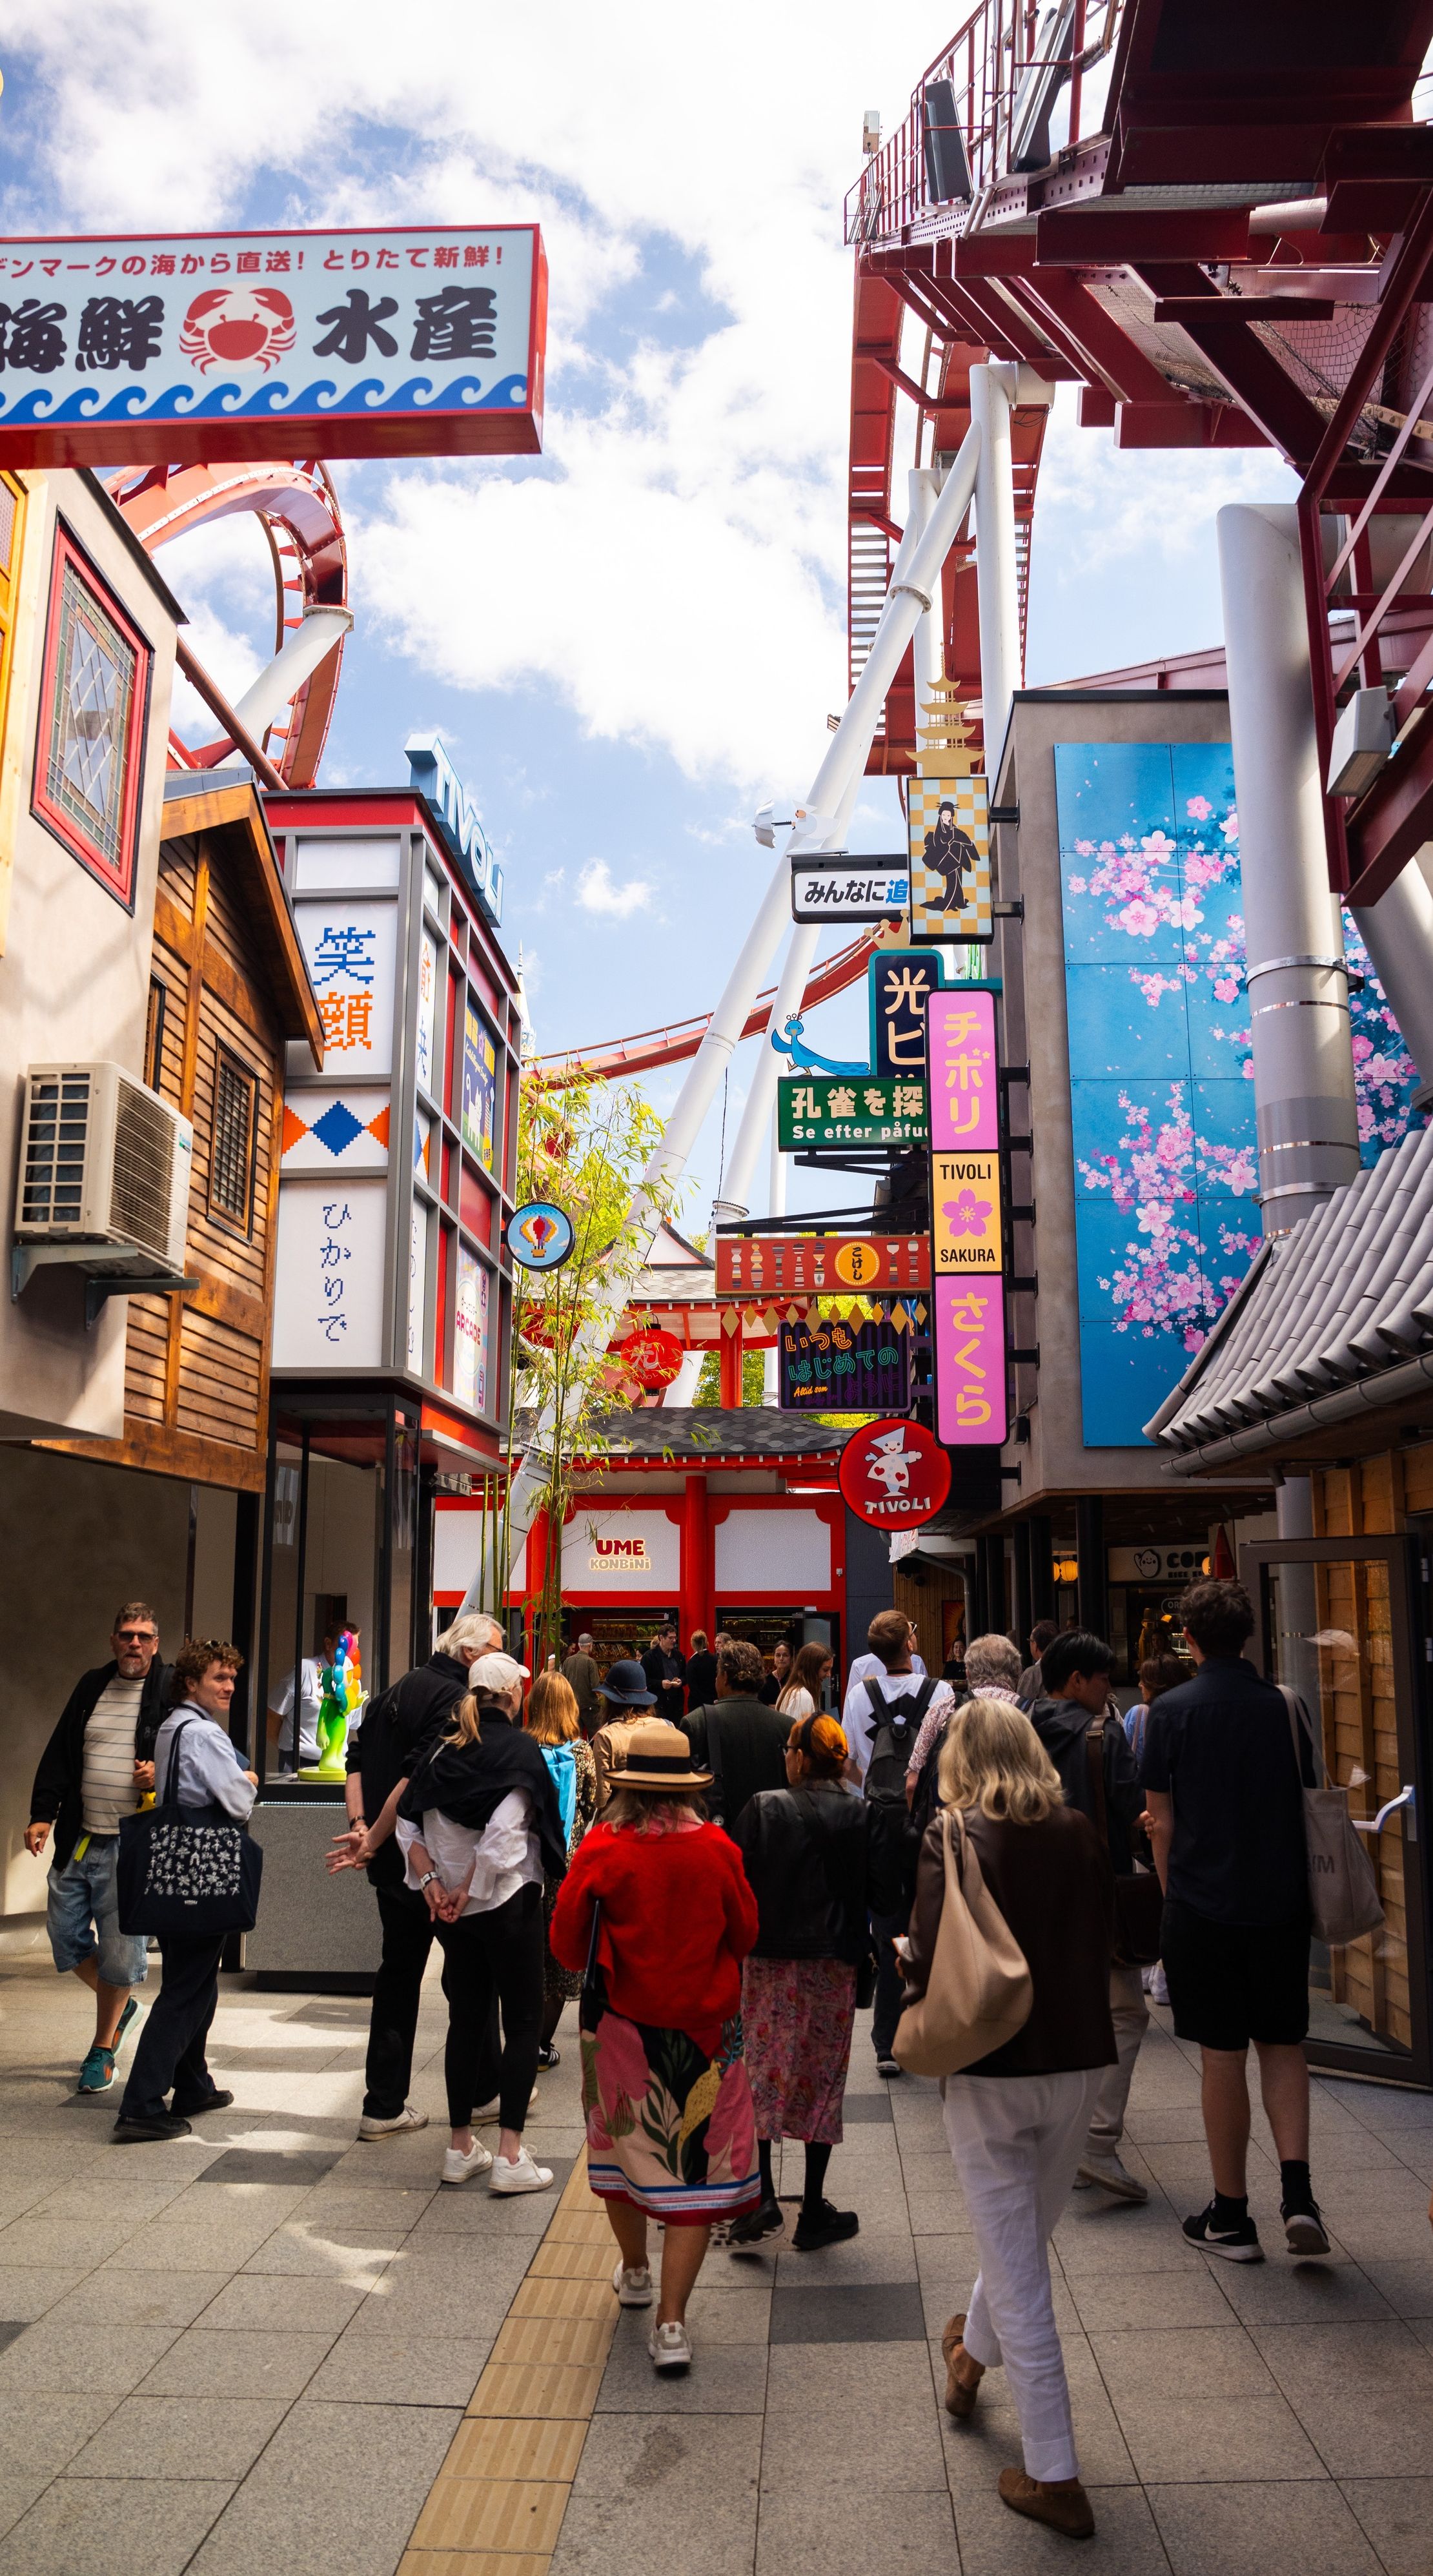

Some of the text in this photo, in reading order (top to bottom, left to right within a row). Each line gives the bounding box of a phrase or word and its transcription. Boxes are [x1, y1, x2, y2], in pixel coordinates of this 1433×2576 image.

[0, 285, 498, 374] 海鮮 水産
[418, 735, 504, 928] TIVOLI
[791, 1085, 924, 1119] 孔雀を探
[793, 1125, 815, 1139] Se
[824, 1124, 872, 1139] efter
[940, 1163, 991, 1180] TIVOLI
[851, 1247, 863, 1280] こけし
[940, 1248, 995, 1263] SAKURA
[318, 1203, 352, 1342] ひかりで
[456, 1310, 481, 1346] ARCADE
[785, 1327, 852, 1352] いつも
[788, 1347, 899, 1382] はじめての
[951, 1292, 992, 1427] さくら
[793, 1385, 813, 1398] Altid
[864, 1497, 931, 1514] TIVOLI
[596, 1539, 644, 1556] UME
